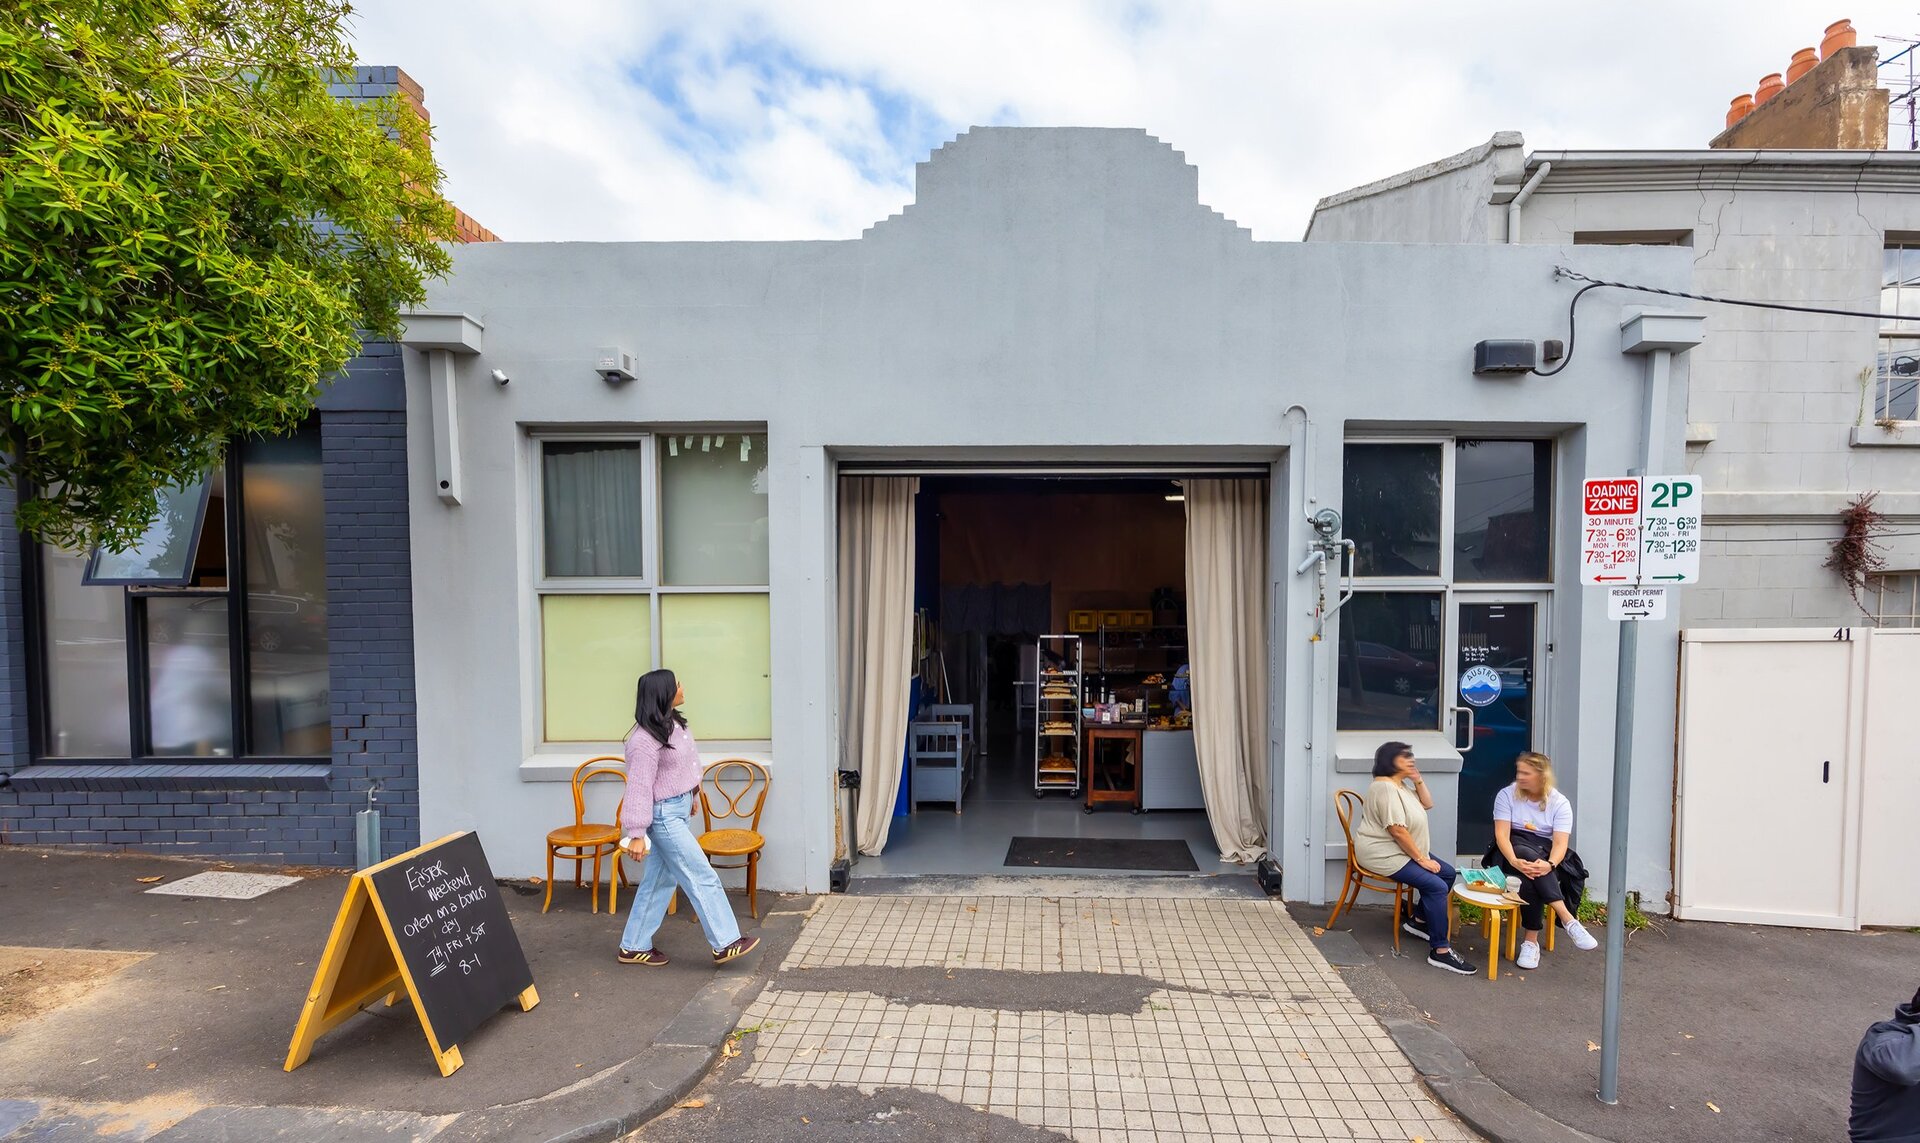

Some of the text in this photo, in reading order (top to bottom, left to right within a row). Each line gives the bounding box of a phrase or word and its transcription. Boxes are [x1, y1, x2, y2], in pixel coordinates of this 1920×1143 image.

[1586, 484, 1636, 498] LOADING
[1651, 482, 1694, 508] 2P
[1590, 498, 1634, 511] ZONE
[1588, 518, 1601, 526] 30
[1622, 599, 1654, 608] AREA 5
[1833, 627, 1850, 640] 41
[1466, 668, 1497, 682] AUSTRO
[436, 906, 450, 919] on
[450, 902, 458, 912] a
[458, 886, 486, 908] bonus
[442, 918, 460, 934] day
